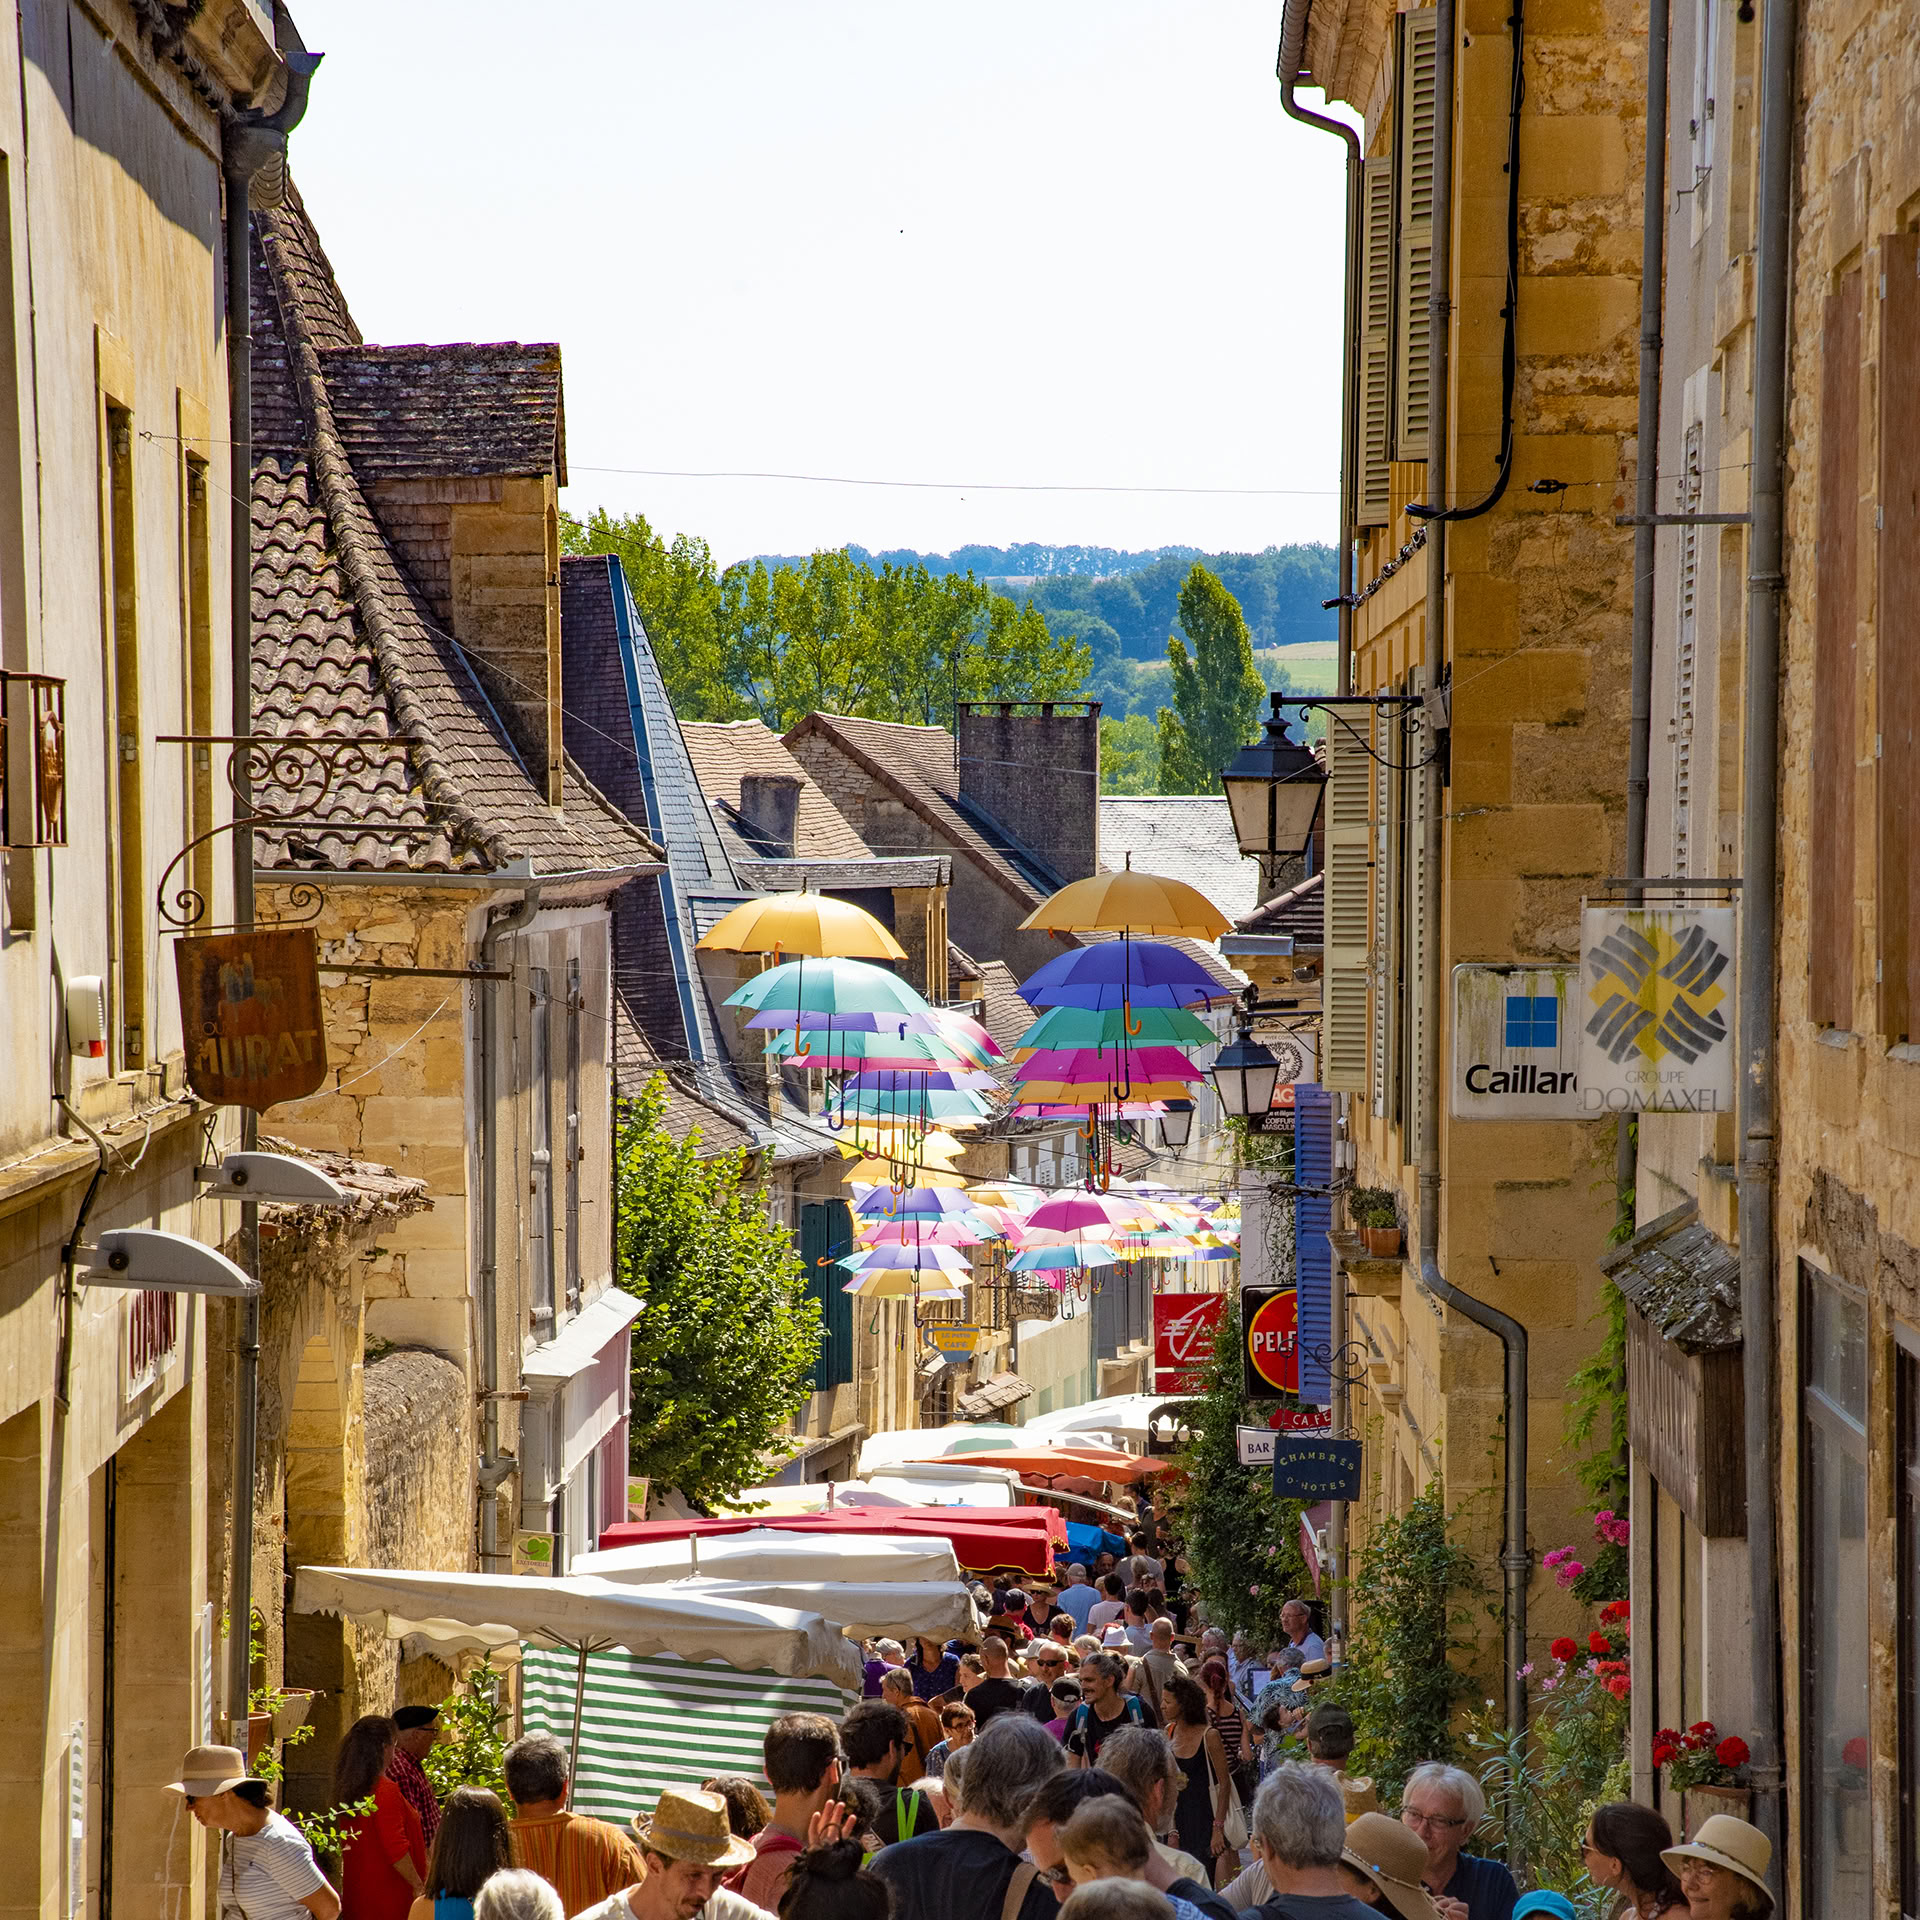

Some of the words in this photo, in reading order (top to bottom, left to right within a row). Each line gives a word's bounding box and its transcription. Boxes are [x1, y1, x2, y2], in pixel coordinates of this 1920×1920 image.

[193, 1029, 318, 1080] MURAT
[1465, 1064, 1577, 1094] Caillar
[1625, 1070, 1685, 1084] GROUPE
[1583, 1087, 1725, 1112] DOMAXEL
[1248, 1442, 1270, 1454] BAR
[1279, 1451, 1355, 1471] CHAMBRES
